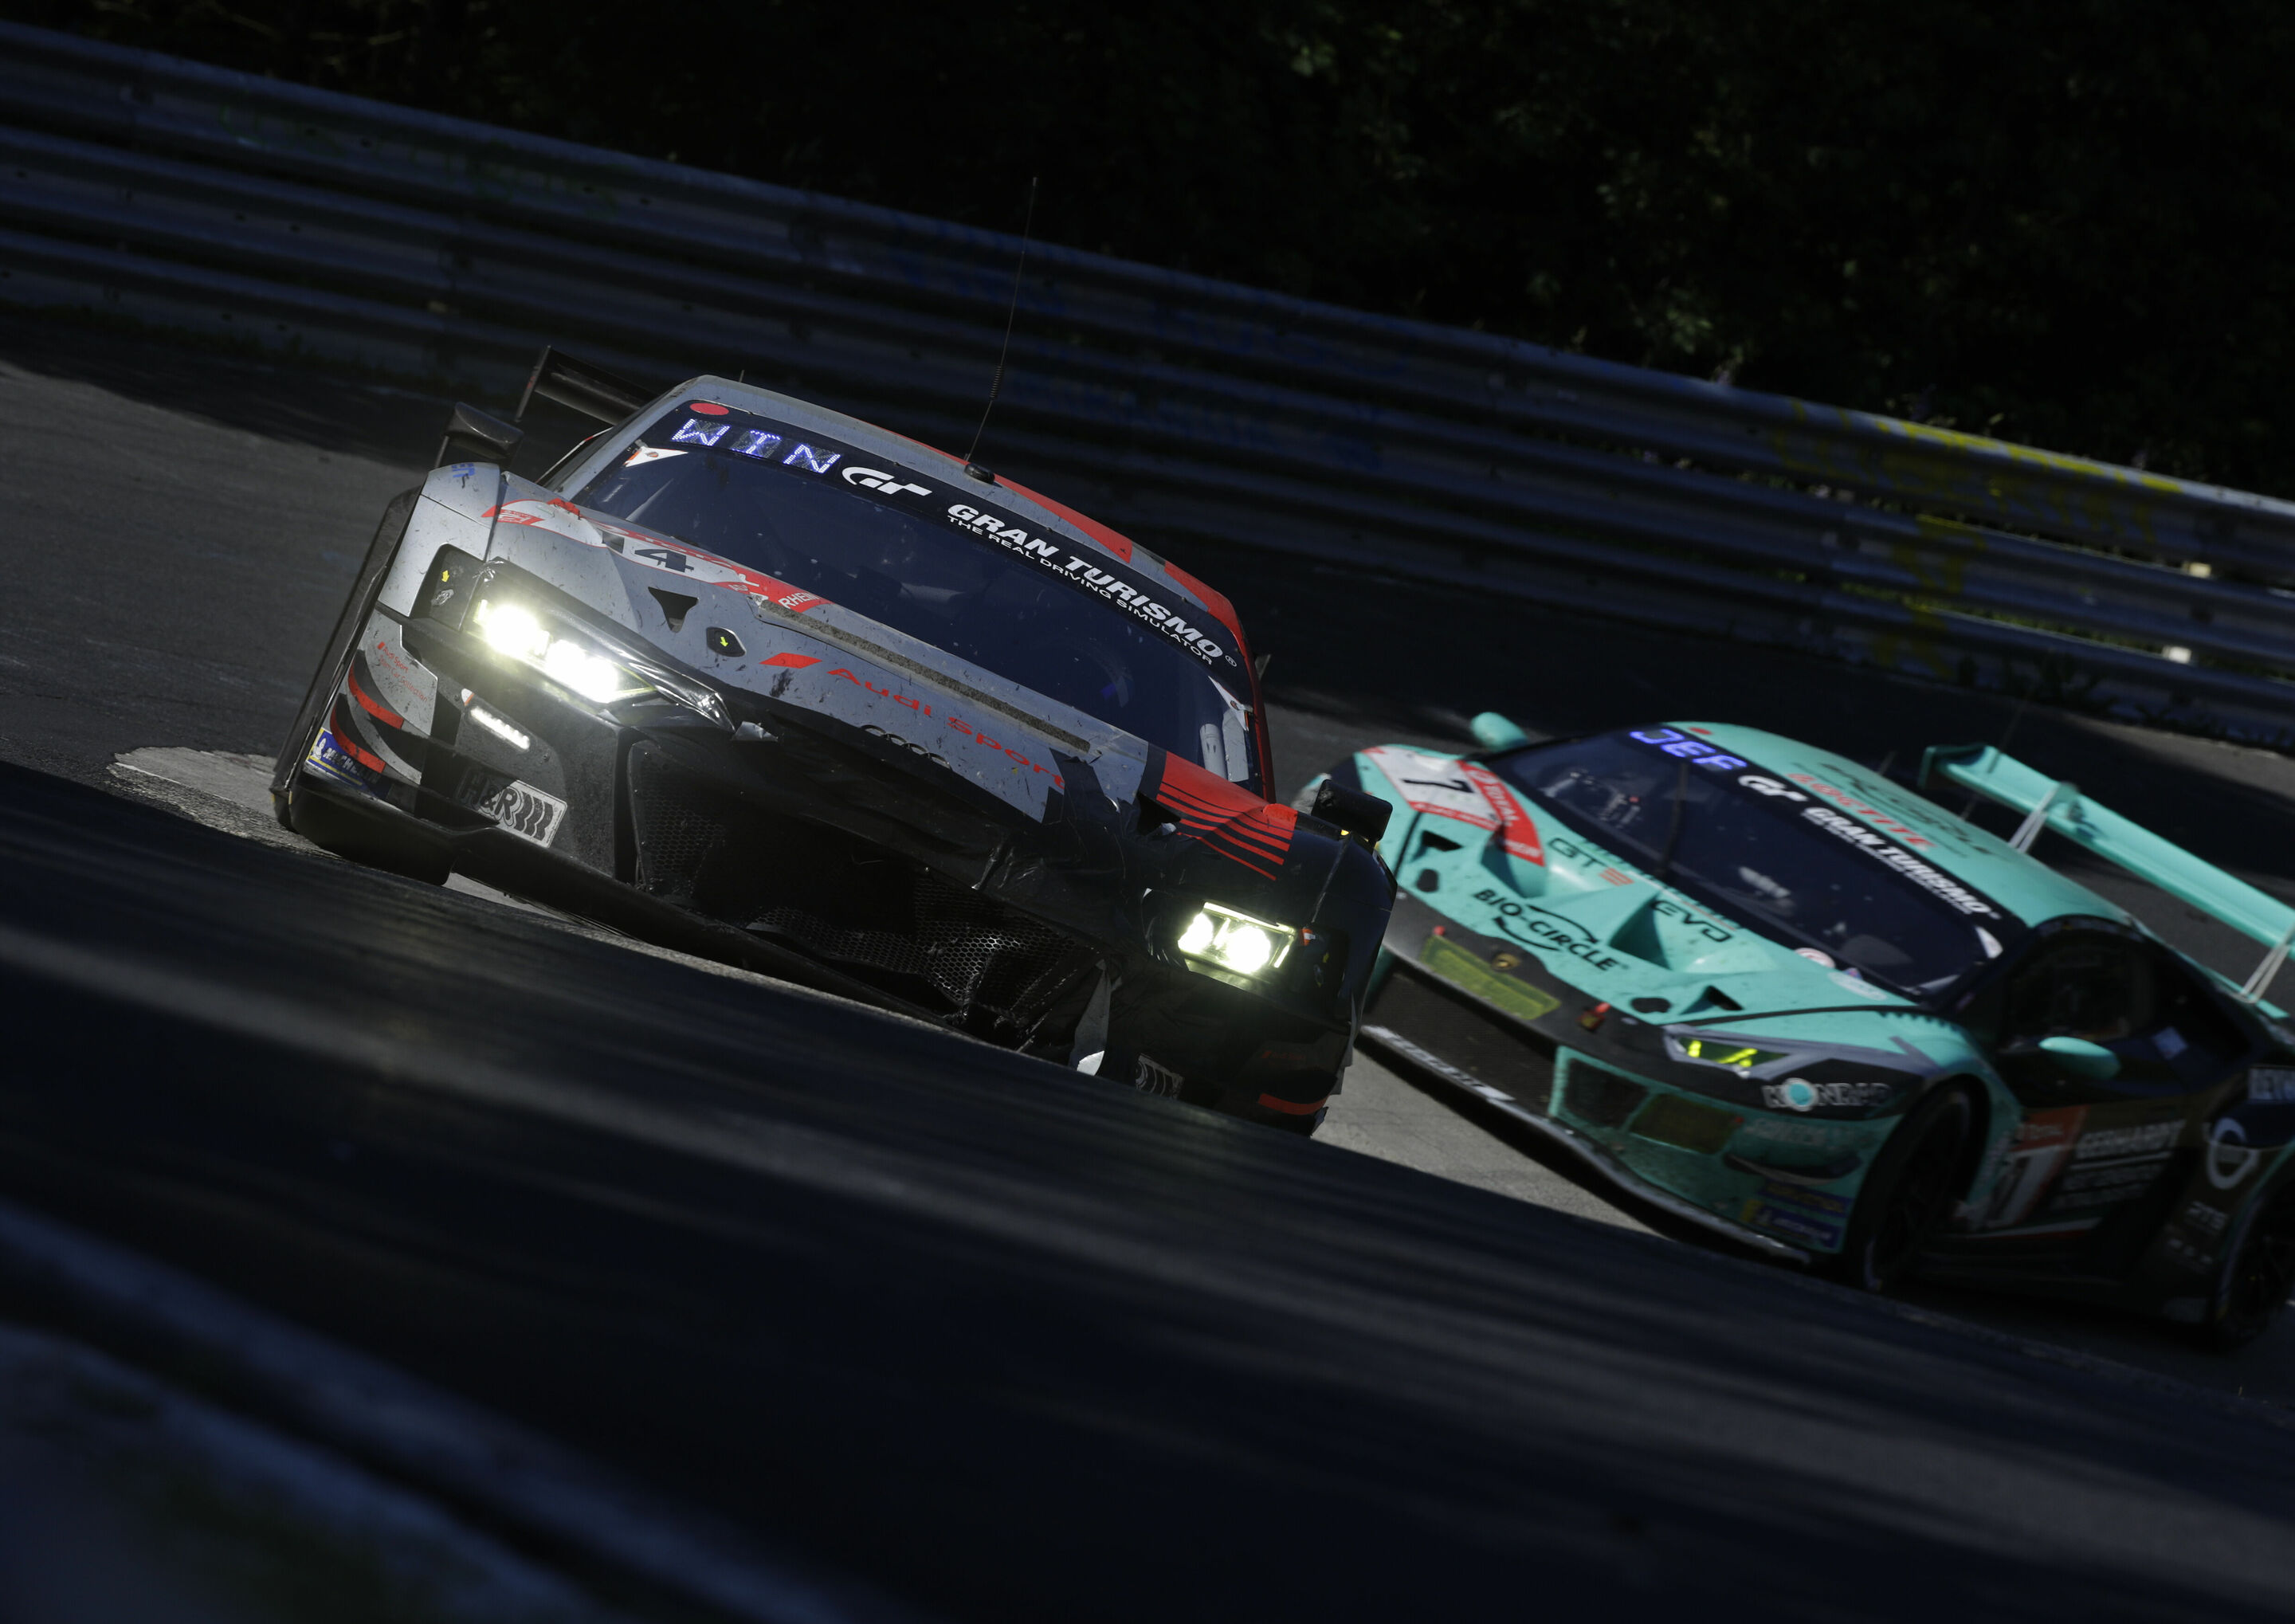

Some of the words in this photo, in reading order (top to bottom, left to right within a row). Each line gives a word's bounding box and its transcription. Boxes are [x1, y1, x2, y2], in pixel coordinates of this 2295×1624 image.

[671, 418, 842, 474] WIN
[947, 504, 1059, 558] GRAN
[1065, 555, 1223, 657] TURISMO
[947, 516, 983, 535] THE
[988, 534, 1035, 560] REAL
[1039, 557, 1112, 600] DRIVING
[1116, 598, 1214, 666] SIMULATOR
[826, 668, 932, 716] Audi
[947, 716, 1065, 790] Sport
[1801, 806, 1886, 845] GRAN
[1650, 900, 1732, 943] EVO
